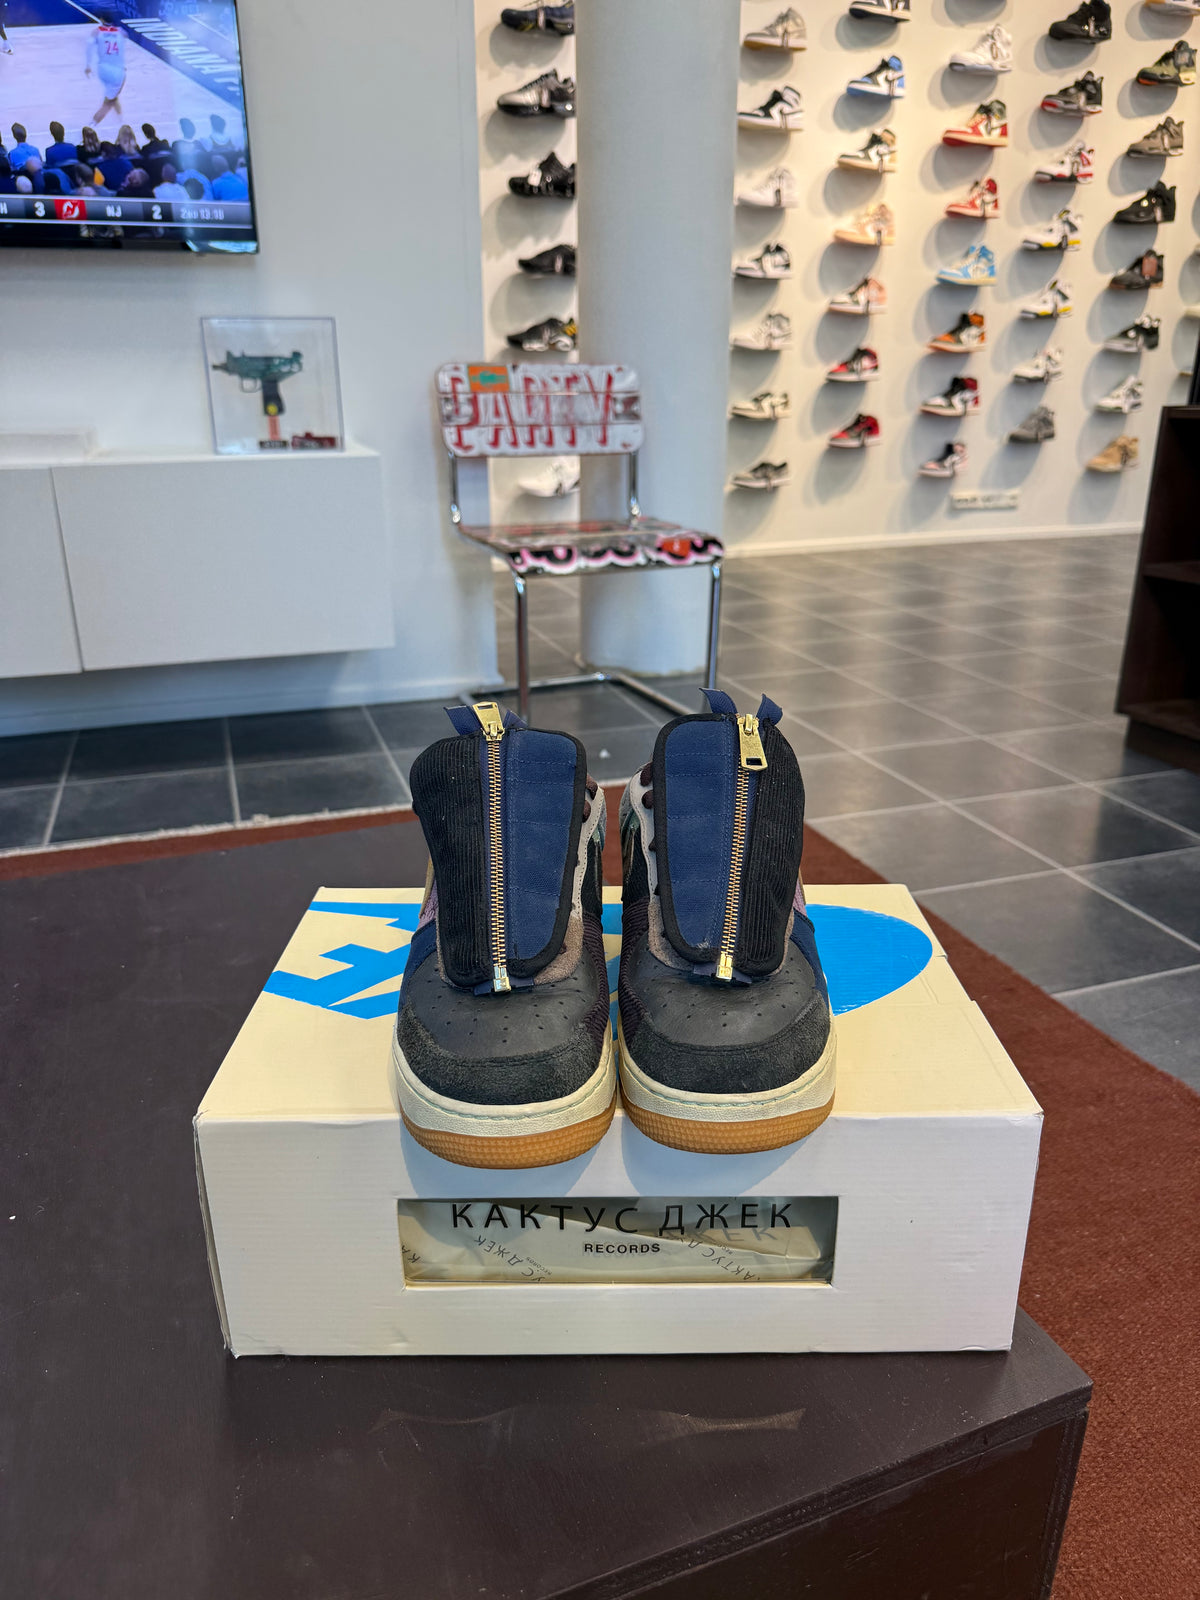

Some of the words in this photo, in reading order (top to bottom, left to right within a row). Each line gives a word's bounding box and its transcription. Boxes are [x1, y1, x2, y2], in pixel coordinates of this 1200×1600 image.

[104, 41, 119, 55] 24
[34, 201, 46, 217] 3
[152, 204, 162, 220] 2
[452, 1203, 638, 1234] КАКТУС
[658, 1203, 792, 1237] ДЖЕК
[584, 1243, 661, 1254] RECORDS
[701, 1247, 761, 1281] АКТУС
